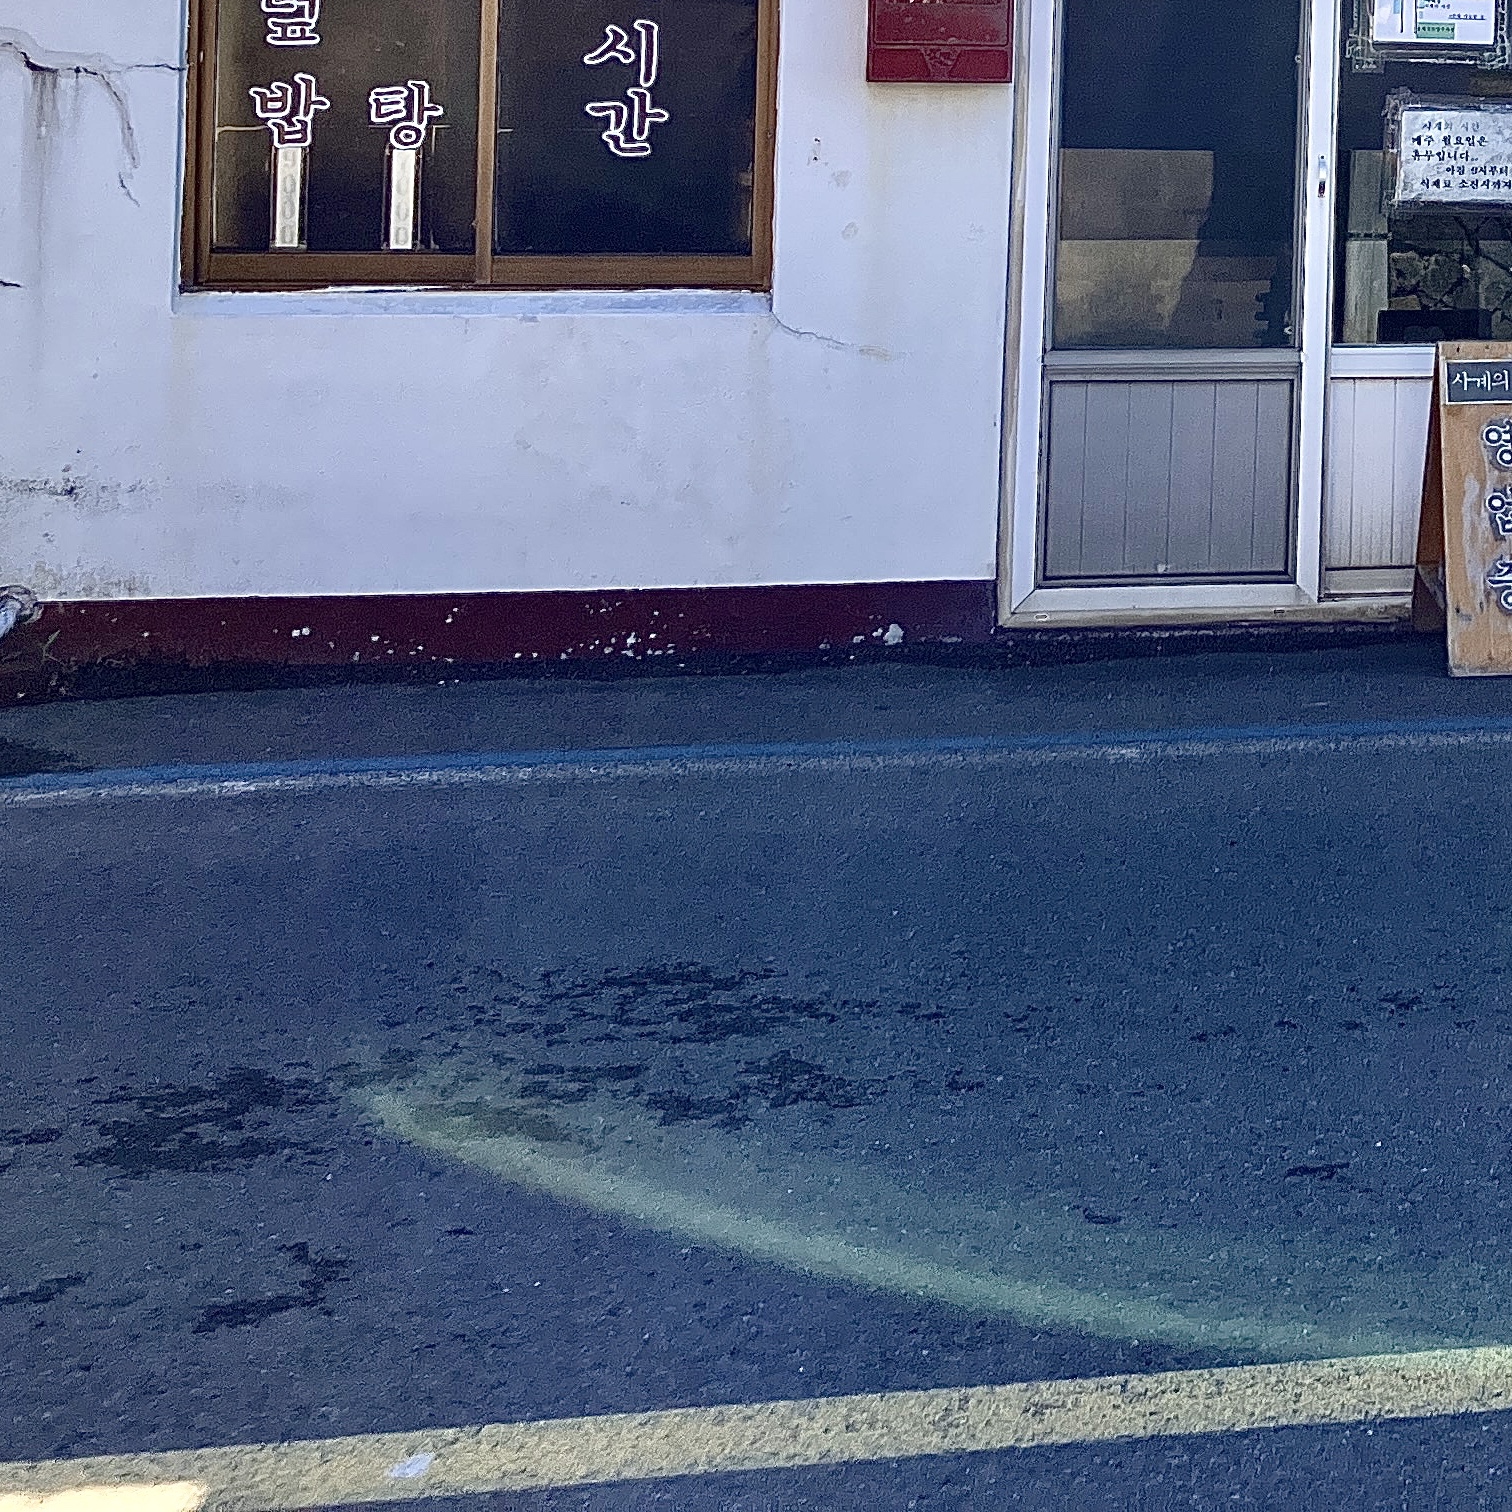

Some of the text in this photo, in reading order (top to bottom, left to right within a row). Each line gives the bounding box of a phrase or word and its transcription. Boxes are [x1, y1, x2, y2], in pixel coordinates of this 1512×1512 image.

[583, 20, 668, 157] 시간
[1442, 135, 1489, 146] 월요일은
[1445, 165, 1465, 176] 아침
[1452, 369, 1509, 392] 사계의
